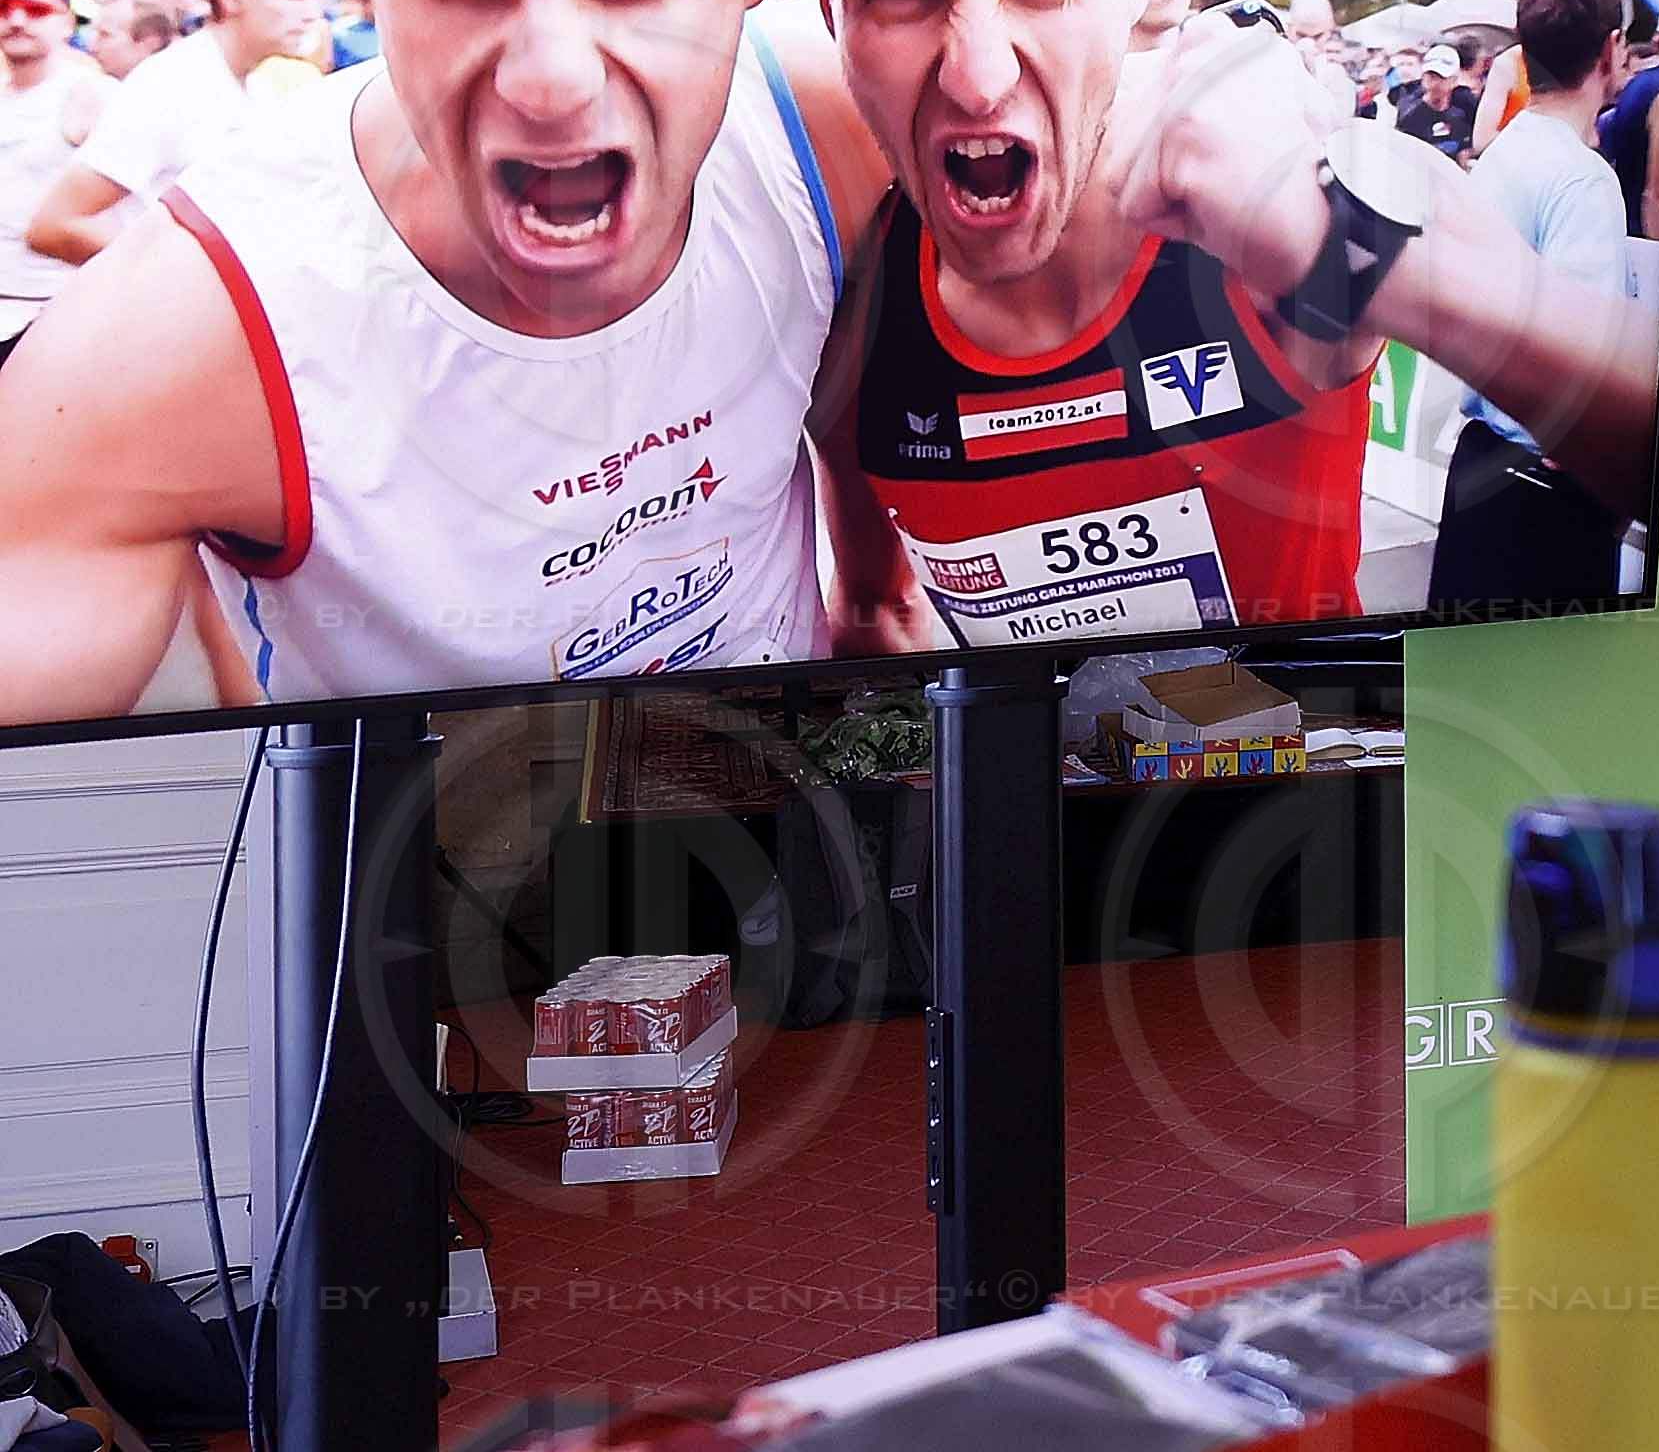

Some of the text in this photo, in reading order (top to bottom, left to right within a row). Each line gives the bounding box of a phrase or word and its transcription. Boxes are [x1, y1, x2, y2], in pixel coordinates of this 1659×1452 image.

[928, 551, 996, 577] KLEINE
[1040, 514, 1159, 575] 583
[980, 589, 1038, 614] ZEITUNG
[1039, 583, 1077, 603] GRAZ
[1076, 569, 1154, 595] MARATHON
[1153, 563, 1186, 580] 2017
[1008, 598, 1128, 640] Michael
[568, 1138, 600, 1148] ACTIVE
